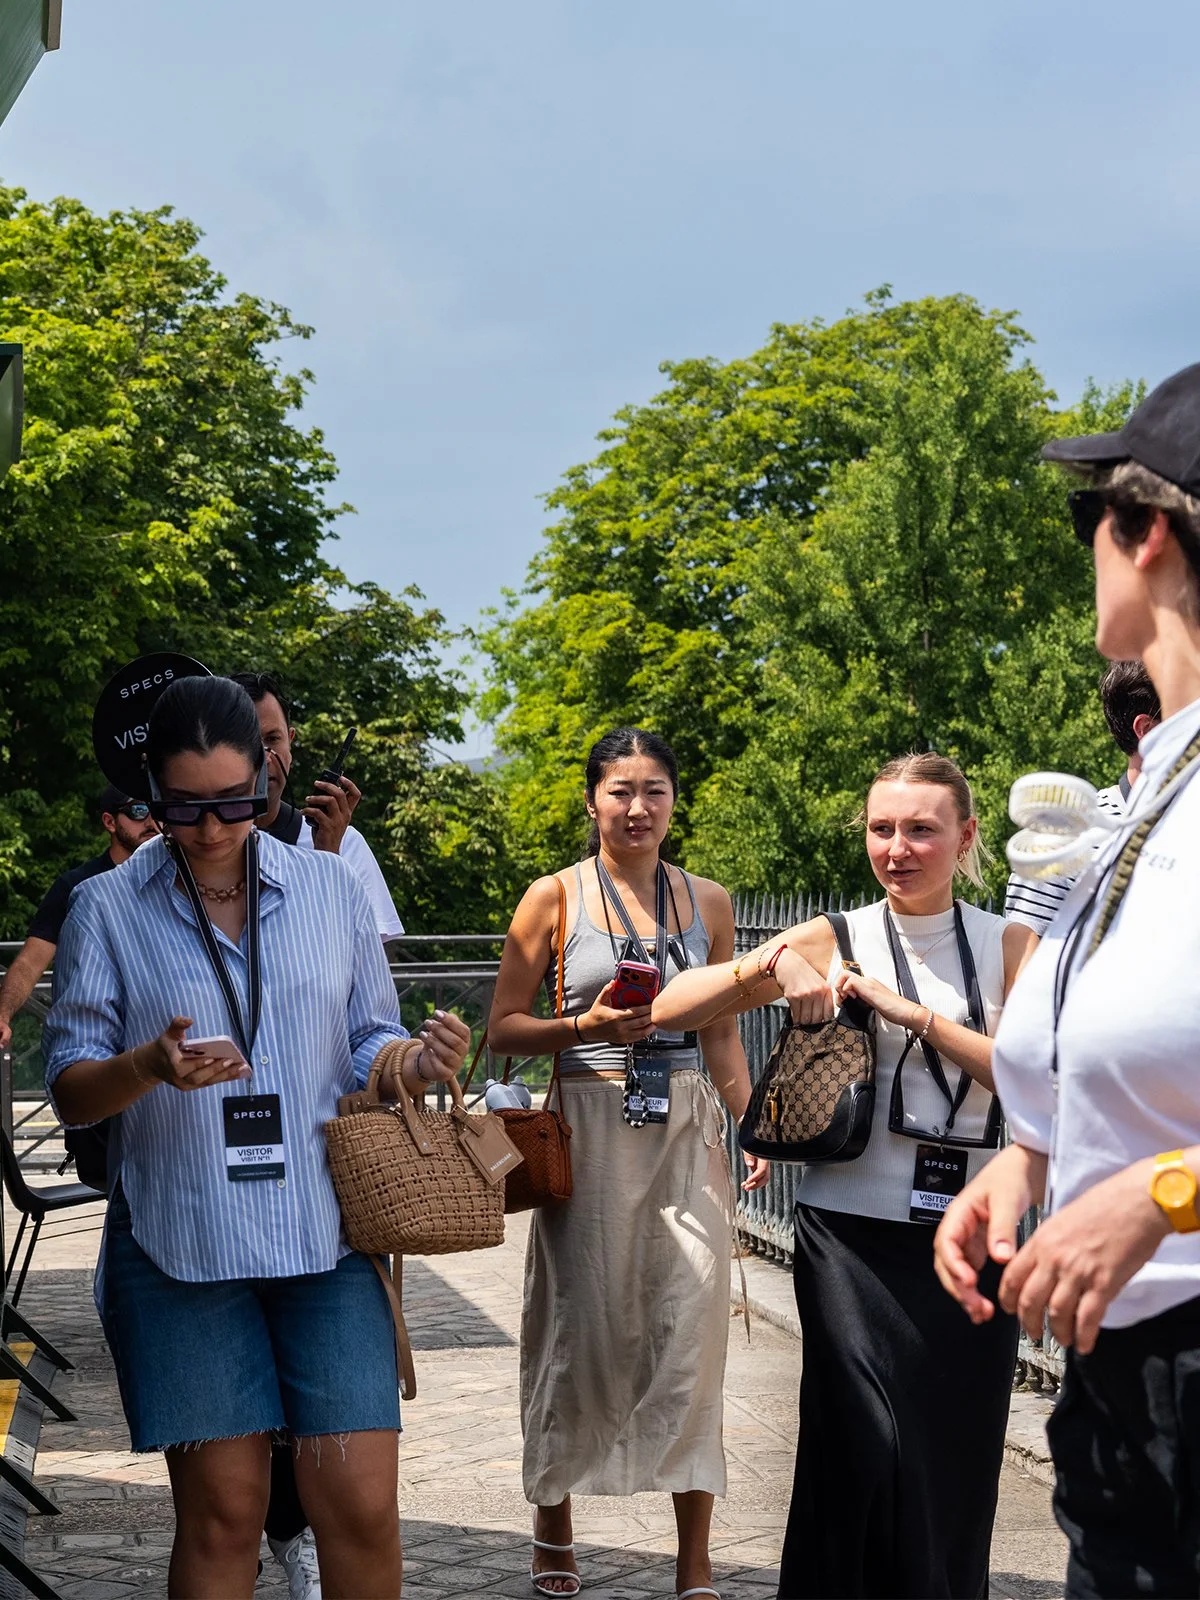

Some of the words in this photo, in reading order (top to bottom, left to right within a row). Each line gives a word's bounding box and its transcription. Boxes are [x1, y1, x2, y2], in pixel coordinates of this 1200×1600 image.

[120, 669, 174, 698] SPECS
[630, 1097, 662, 1105] VISEUR
[233, 1110, 272, 1119] SPECS
[237, 1147, 273, 1156] VISITOR
[924, 1159, 958, 1170] SPECS
